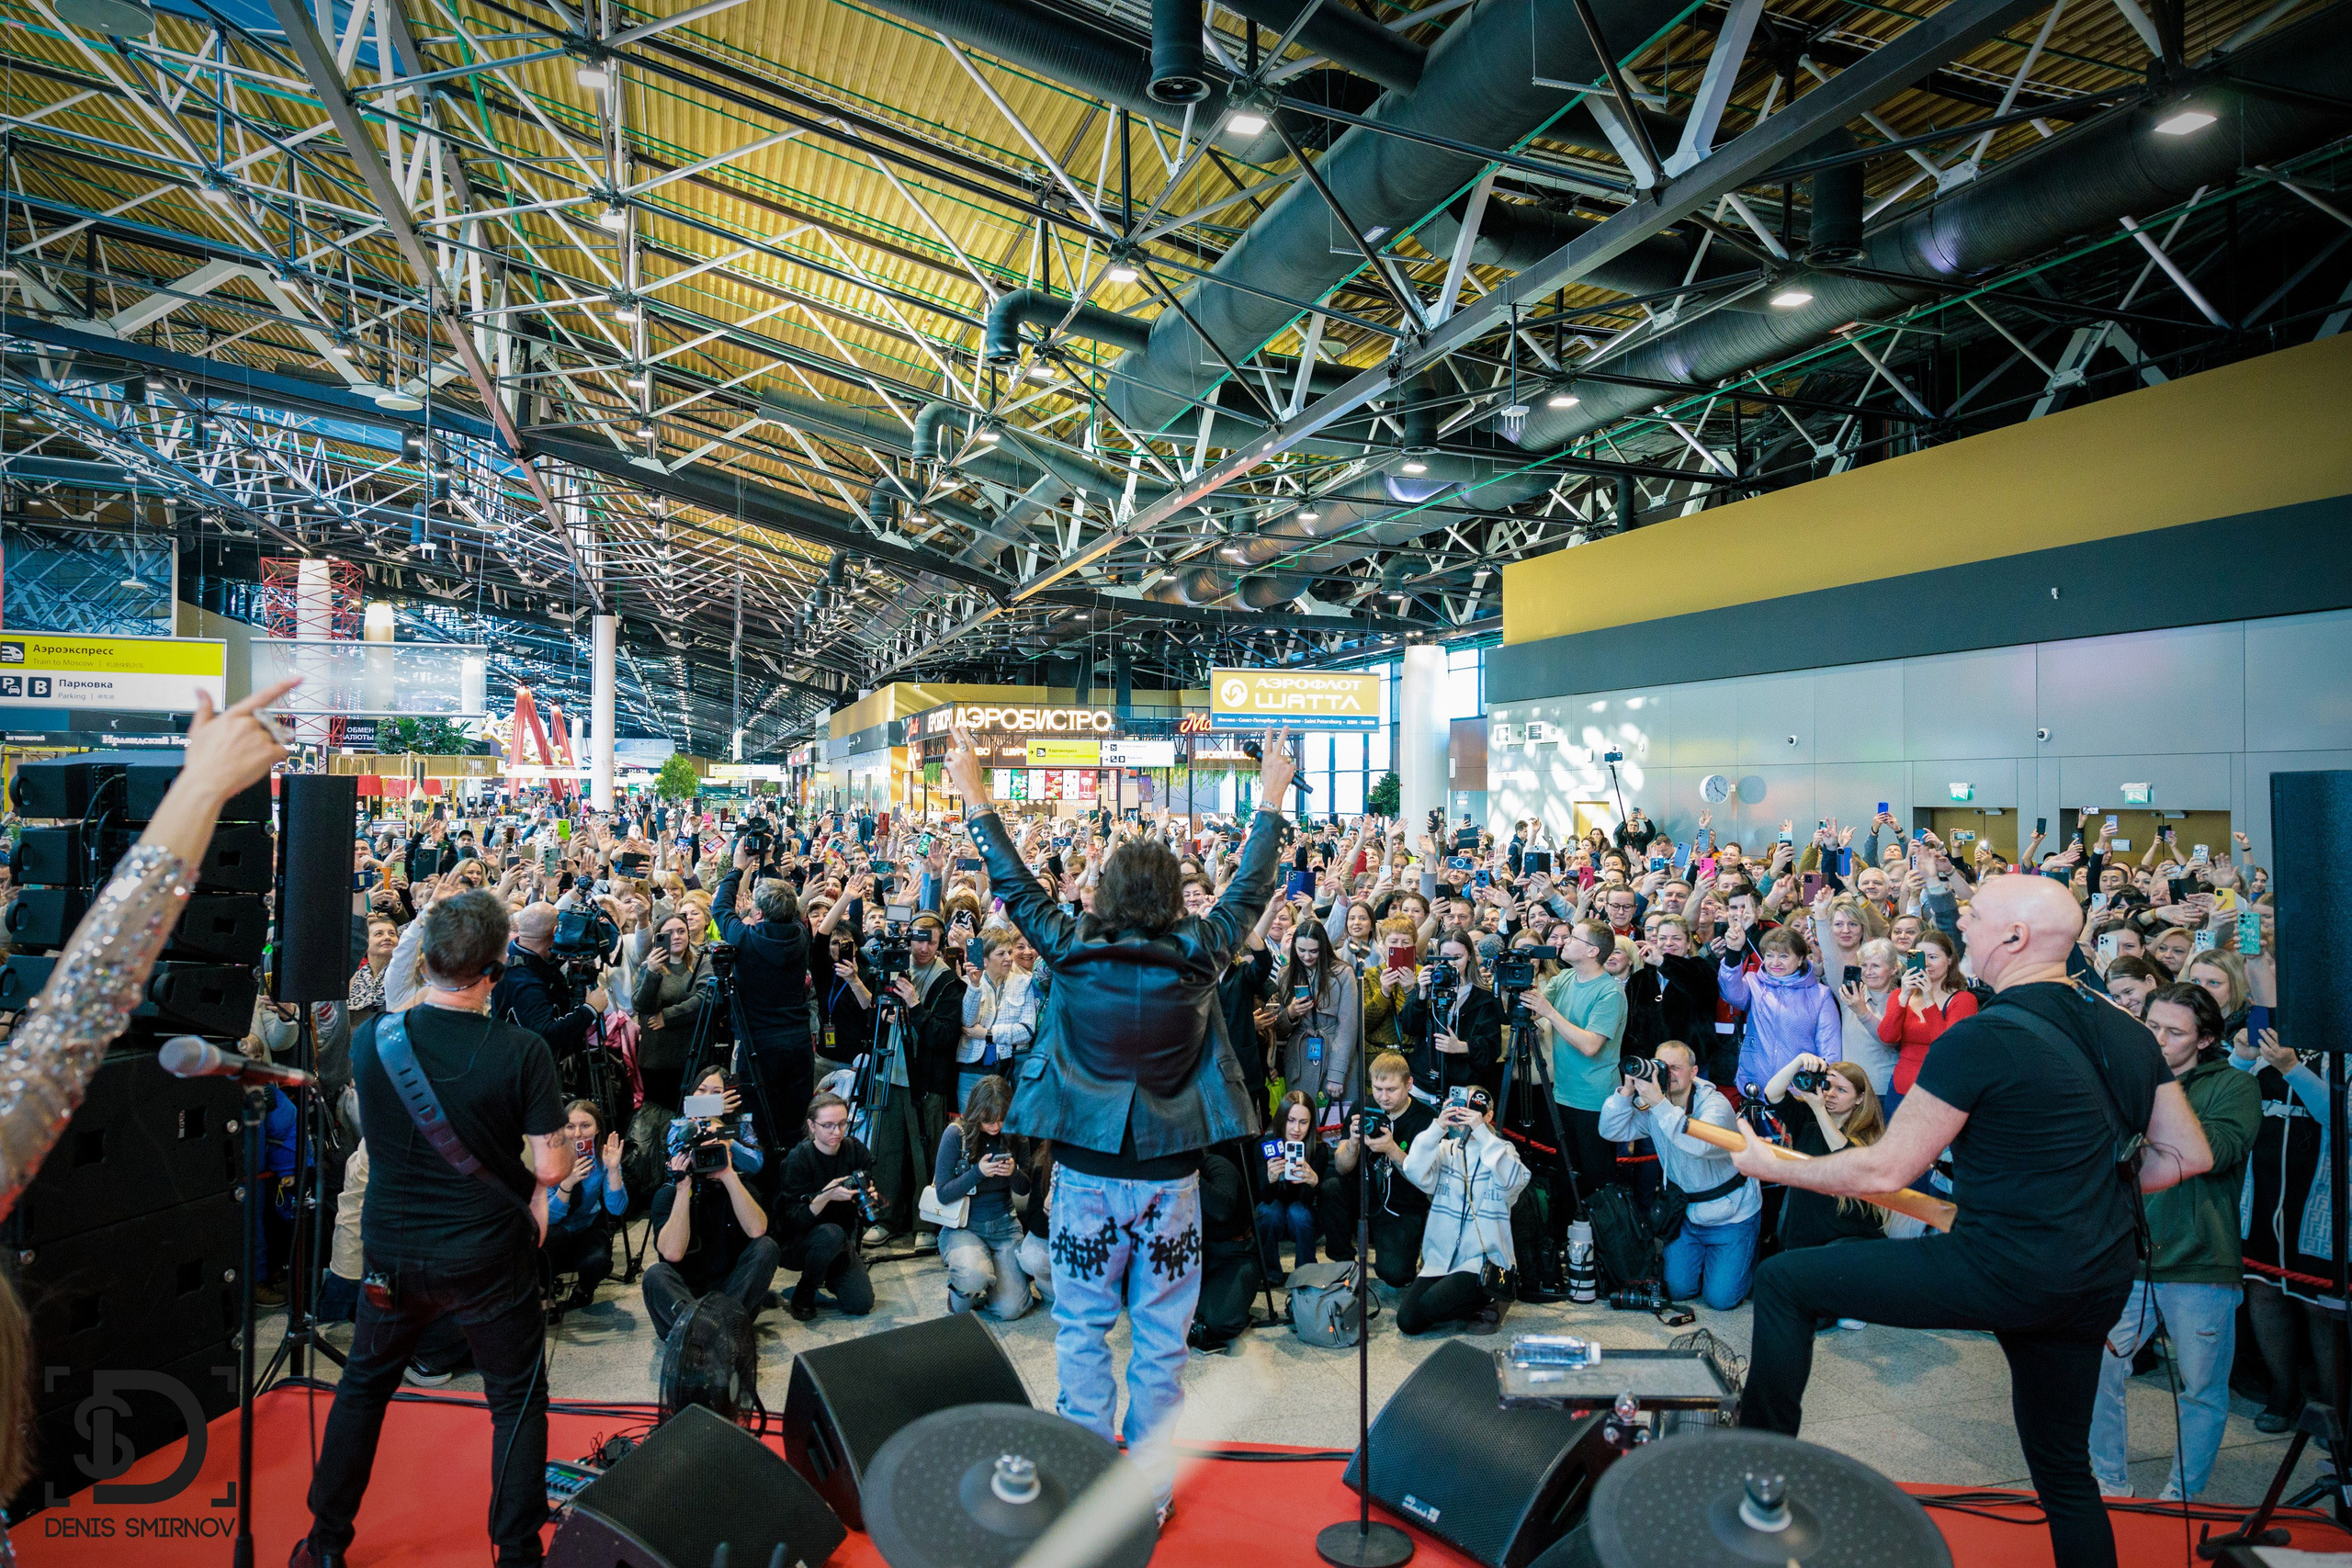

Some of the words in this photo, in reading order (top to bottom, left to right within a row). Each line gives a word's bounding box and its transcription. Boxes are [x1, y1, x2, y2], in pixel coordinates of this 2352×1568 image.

[33, 644, 114, 656] Аэроэкспресс
[33, 658, 52, 666] Train
[3, 678, 15, 689] P
[35, 681, 47, 694] B
[59, 679, 113, 690] Парковка
[1255, 677, 1362, 692] АЭРОФЛОТ
[58, 693, 85, 701] Parking
[1255, 694, 1362, 710] ШАТТЛ
[955, 706, 1112, 732] АЭРОБИСТРО
[102, 734, 169, 747] Ирландский
[170, 736, 192, 748] Бар
